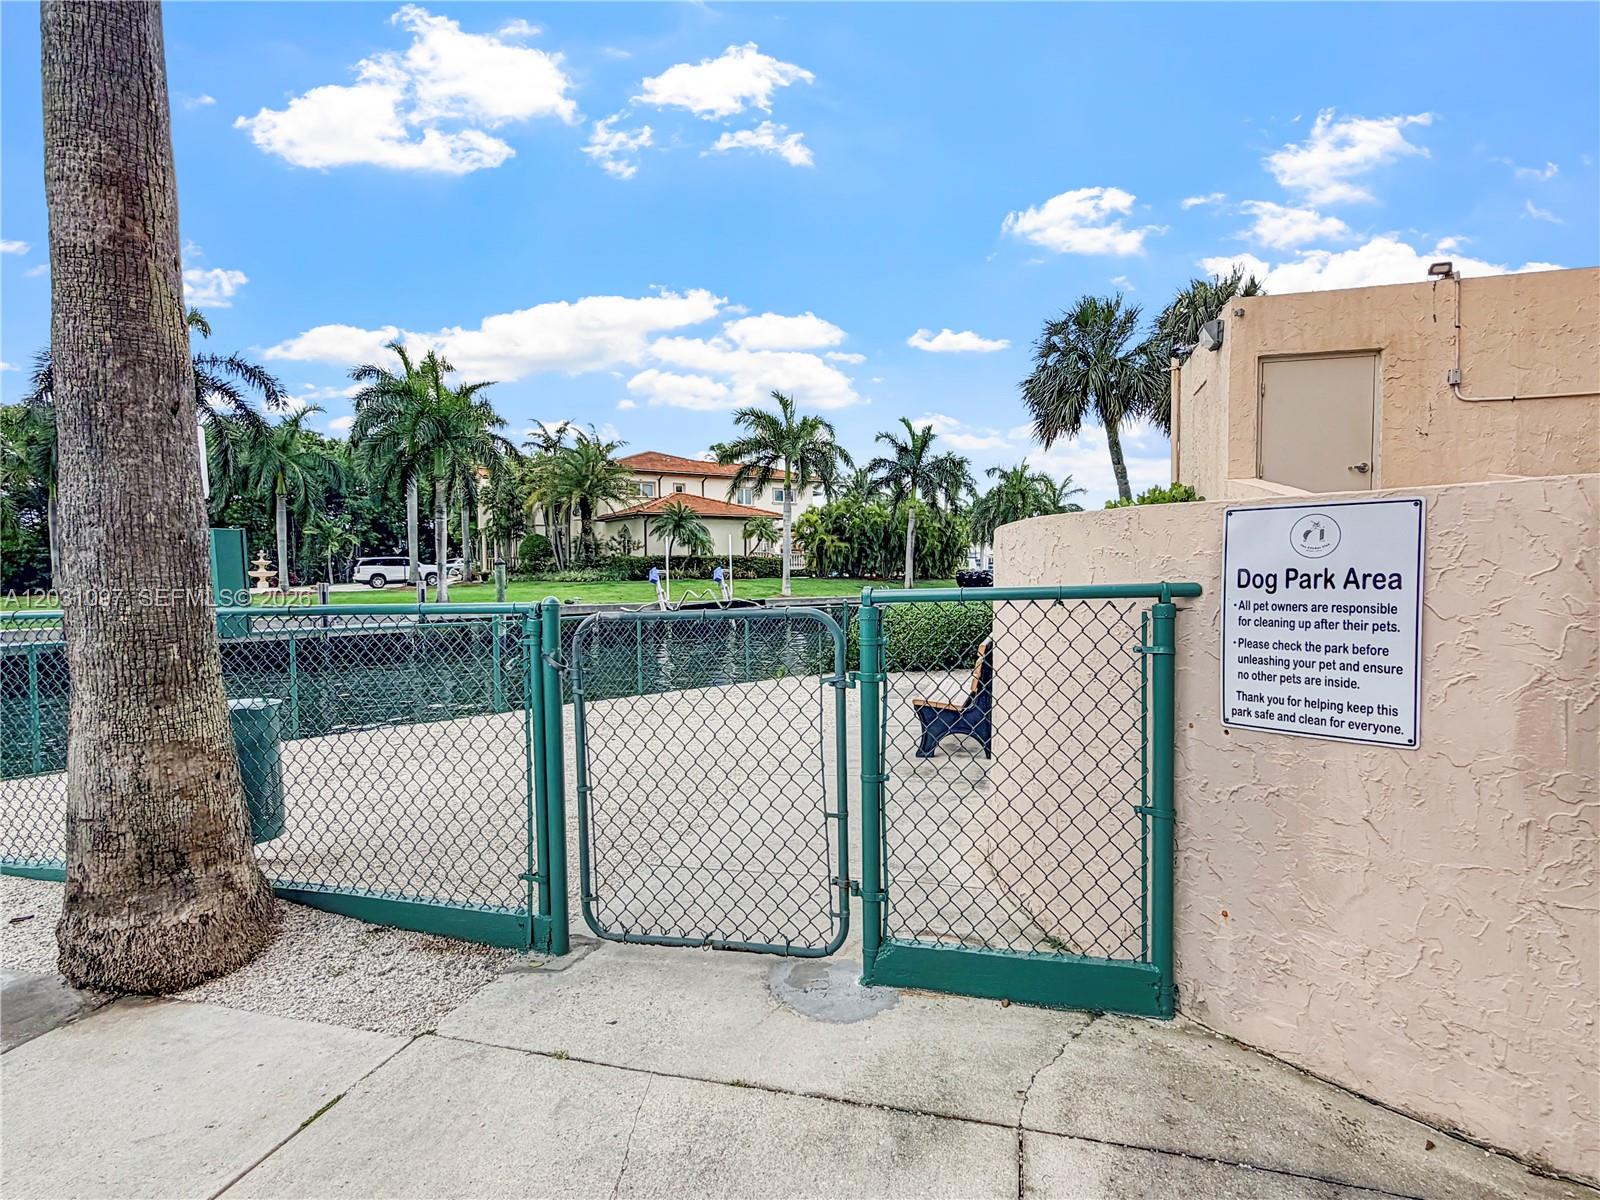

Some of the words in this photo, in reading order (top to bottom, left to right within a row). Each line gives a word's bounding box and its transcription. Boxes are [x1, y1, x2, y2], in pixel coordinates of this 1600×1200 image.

[1237, 569, 1277, 594] Dog
[1286, 568, 1335, 589] Park
[1343, 567, 1402, 590] Area
[1238, 600, 1250, 610] All
[1253, 602, 1269, 613] pet
[1271, 603, 1308, 612] owners
[1311, 604, 1328, 612] are
[1332, 603, 1397, 616] responsible
[1238, 616, 1251, 626] for
[1254, 617, 1295, 631] cleaning
[1299, 621, 1311, 631] up
[1314, 619, 1340, 630] after
[1343, 620, 1369, 631] their
[1372, 621, 1400, 634] pets.
[1238, 638, 1269, 649] Please
[1272, 640, 1302, 651] check
[1305, 641, 1321, 652] the
[1325, 643, 1349, 655] park
[1352, 644, 1389, 656] before
[1238, 655, 1290, 669] unleashing
[1293, 660, 1316, 670] your
[1319, 660, 1336, 672] pet
[1339, 661, 1359, 672] and
[1363, 664, 1403, 675] ensure
[1252, 672, 1277, 682] other
[1280, 674, 1301, 685] pets
[1304, 677, 1321, 686] are
[1325, 676, 1359, 689] inside.
[1236, 691, 1264, 703] Thank
[1267, 696, 1284, 706] you
[1287, 696, 1302, 707] for
[1305, 697, 1343, 714] helping
[1347, 701, 1373, 716] keep
[1377, 704, 1398, 716] this
[1232, 708, 1252, 717] park
[1255, 710, 1274, 720] safe
[1277, 712, 1295, 723] and
[1299, 714, 1326, 726] clean
[1330, 716, 1345, 728] for
[1348, 721, 1404, 735] everyone.
